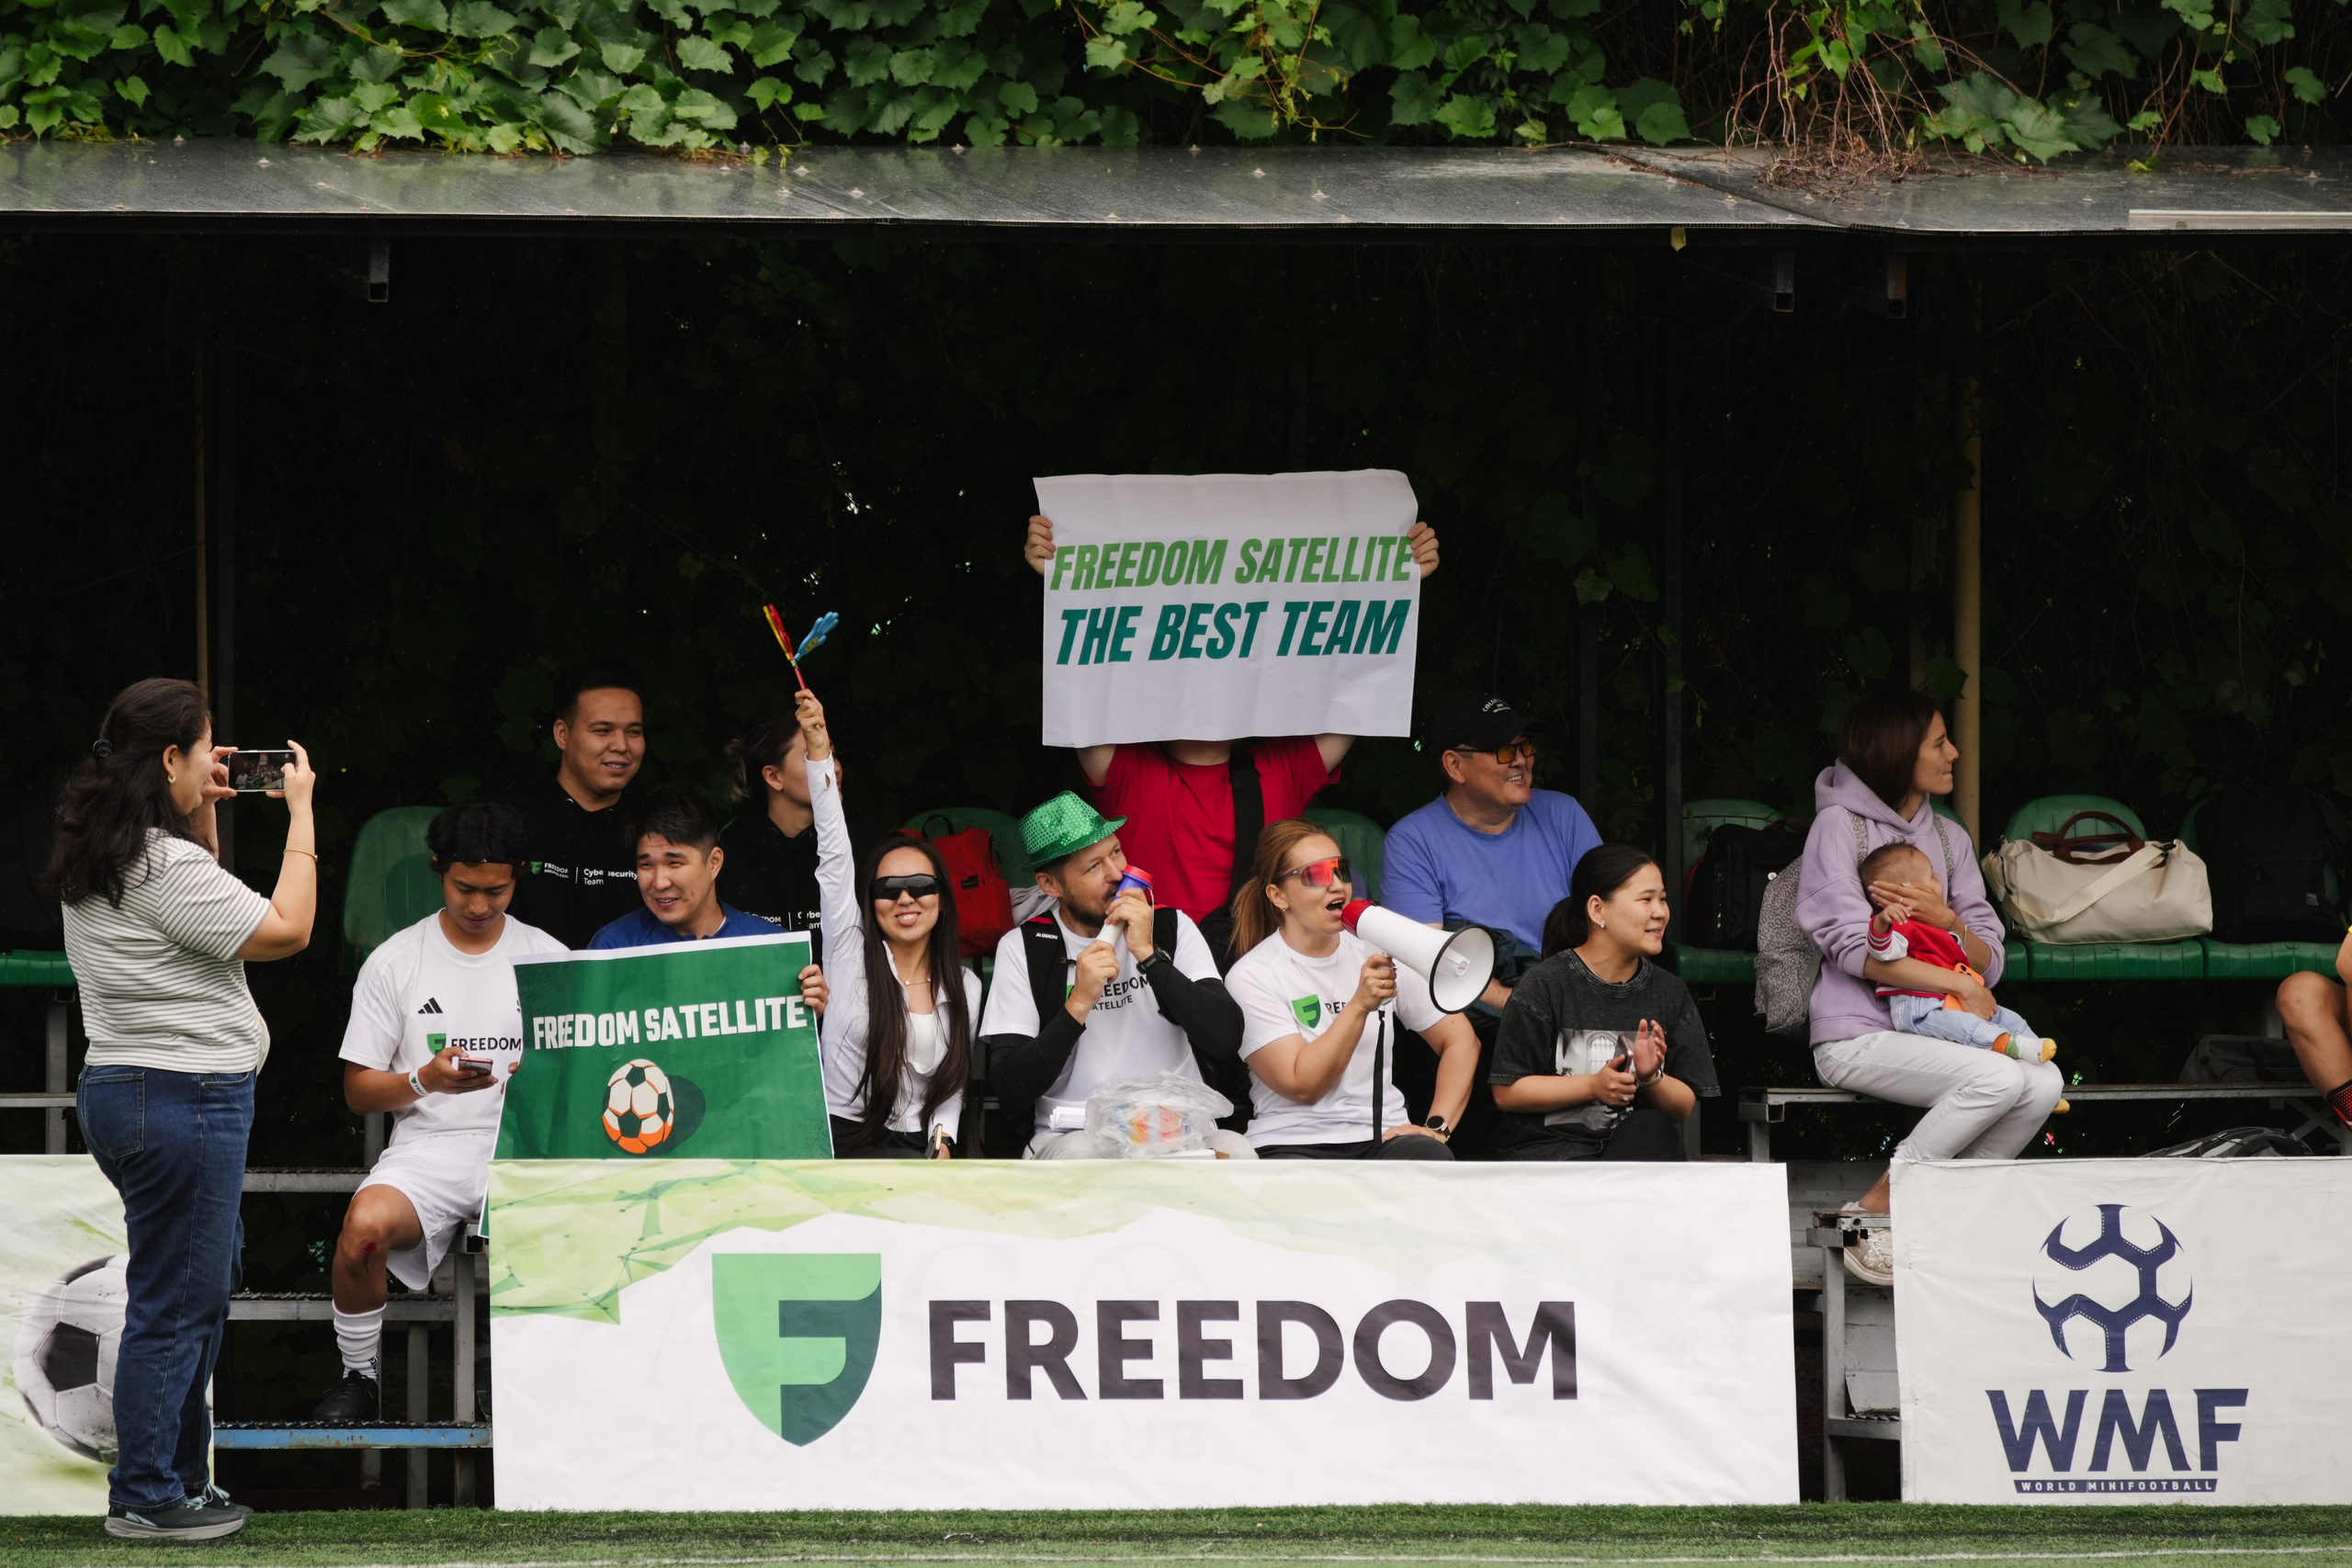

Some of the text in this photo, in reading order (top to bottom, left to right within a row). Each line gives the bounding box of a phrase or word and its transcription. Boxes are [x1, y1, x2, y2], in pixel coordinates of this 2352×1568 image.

[1049, 536, 1413, 591] FREEDOM SATELLITE
[1057, 599, 1412, 666] THE BEST TEAM
[582, 877, 604, 886] Team
[532, 994, 808, 1050] FREEDOM SATELLITE
[929, 1299, 1578, 1402] FREEDOM
[1984, 1388, 2249, 1472] WMF
[2020, 1481, 2212, 1492] WORLD MINIFOOTBALL
